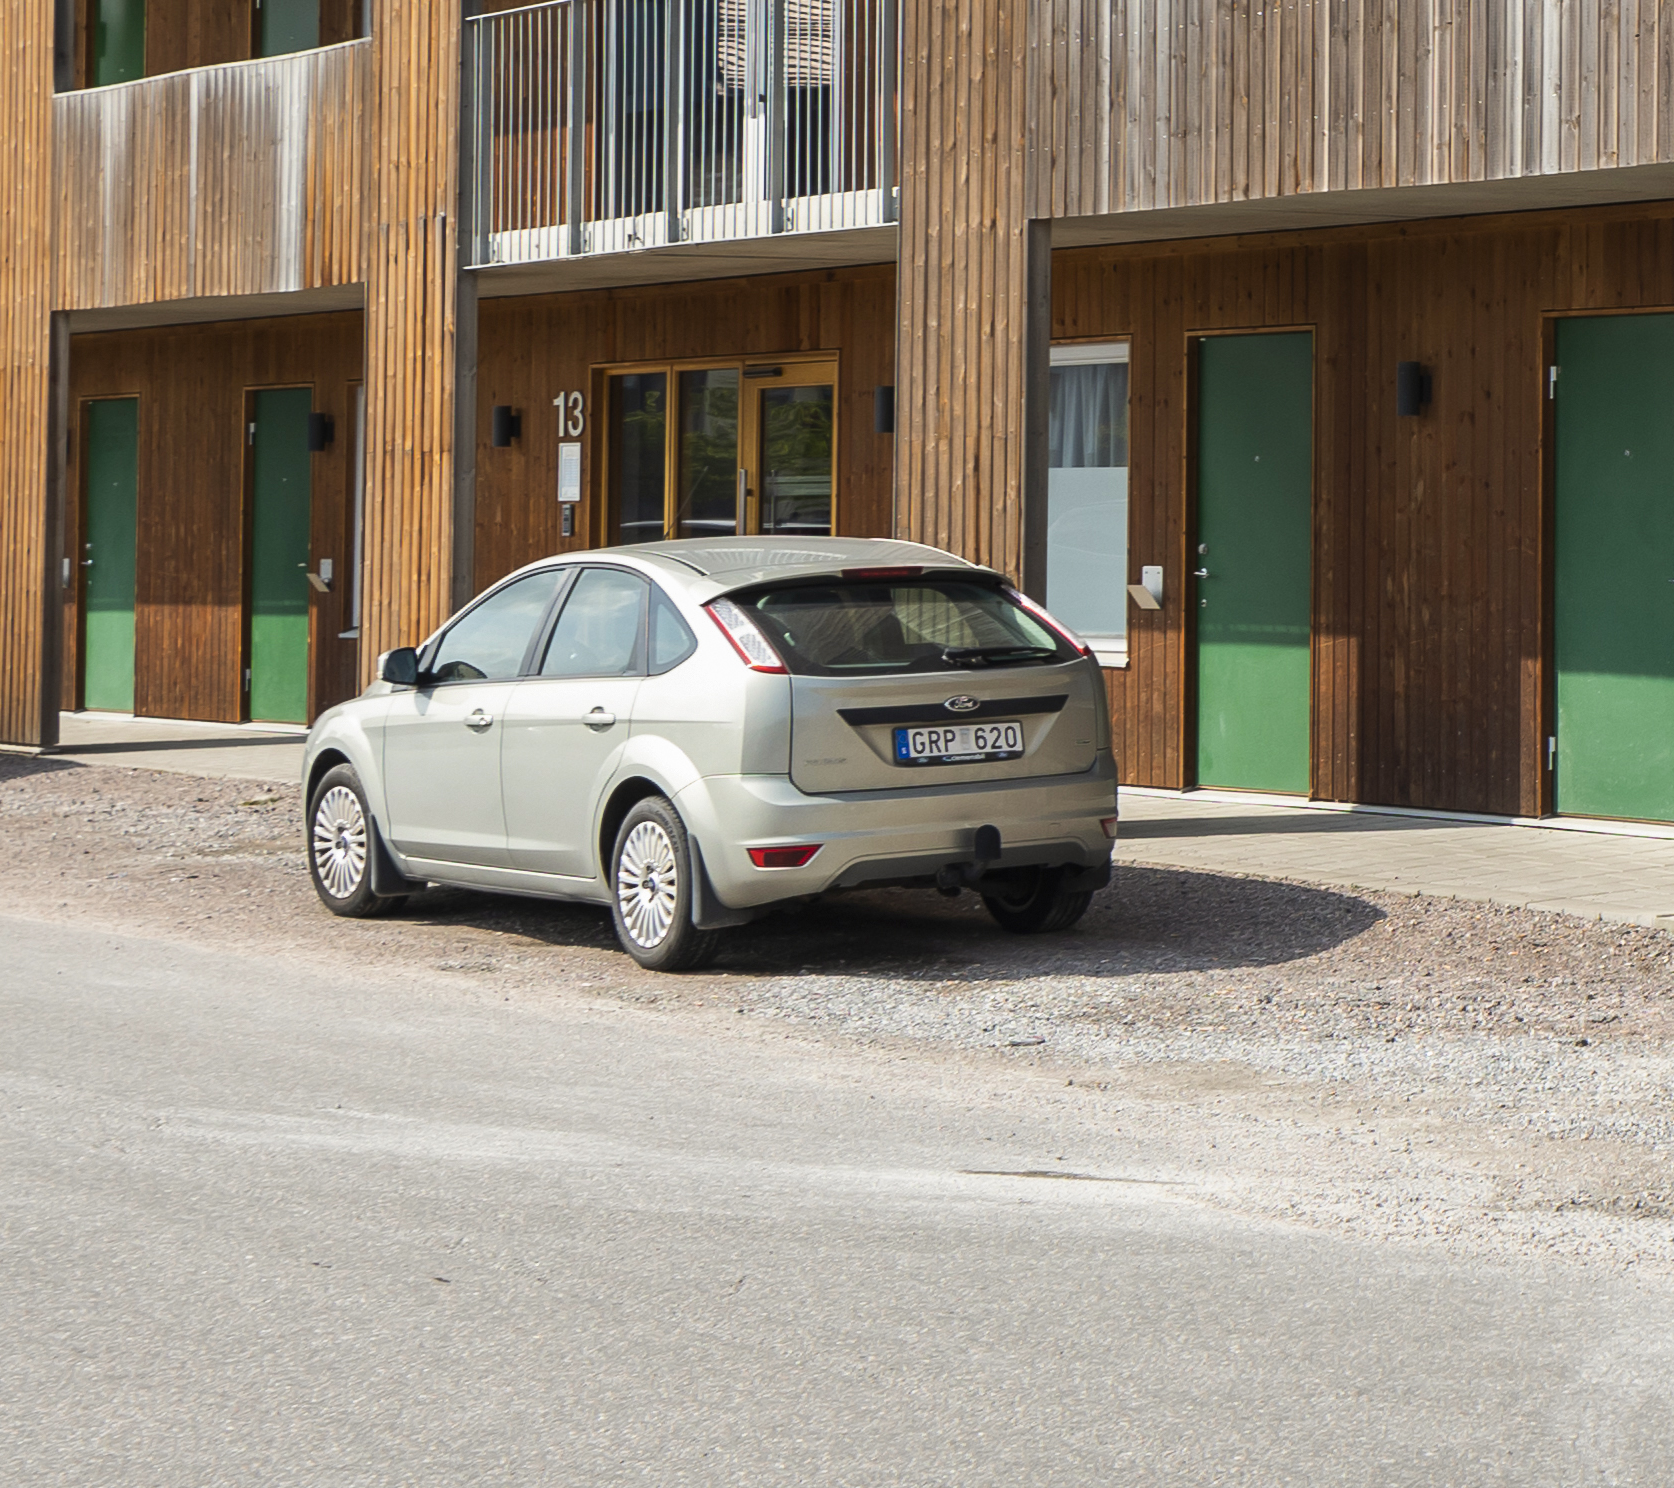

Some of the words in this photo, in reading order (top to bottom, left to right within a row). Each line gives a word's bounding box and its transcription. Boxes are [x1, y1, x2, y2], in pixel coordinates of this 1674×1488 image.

[553, 391, 584, 437] 13
[912, 729, 956, 754] GRP
[974, 726, 1017, 750] 620
